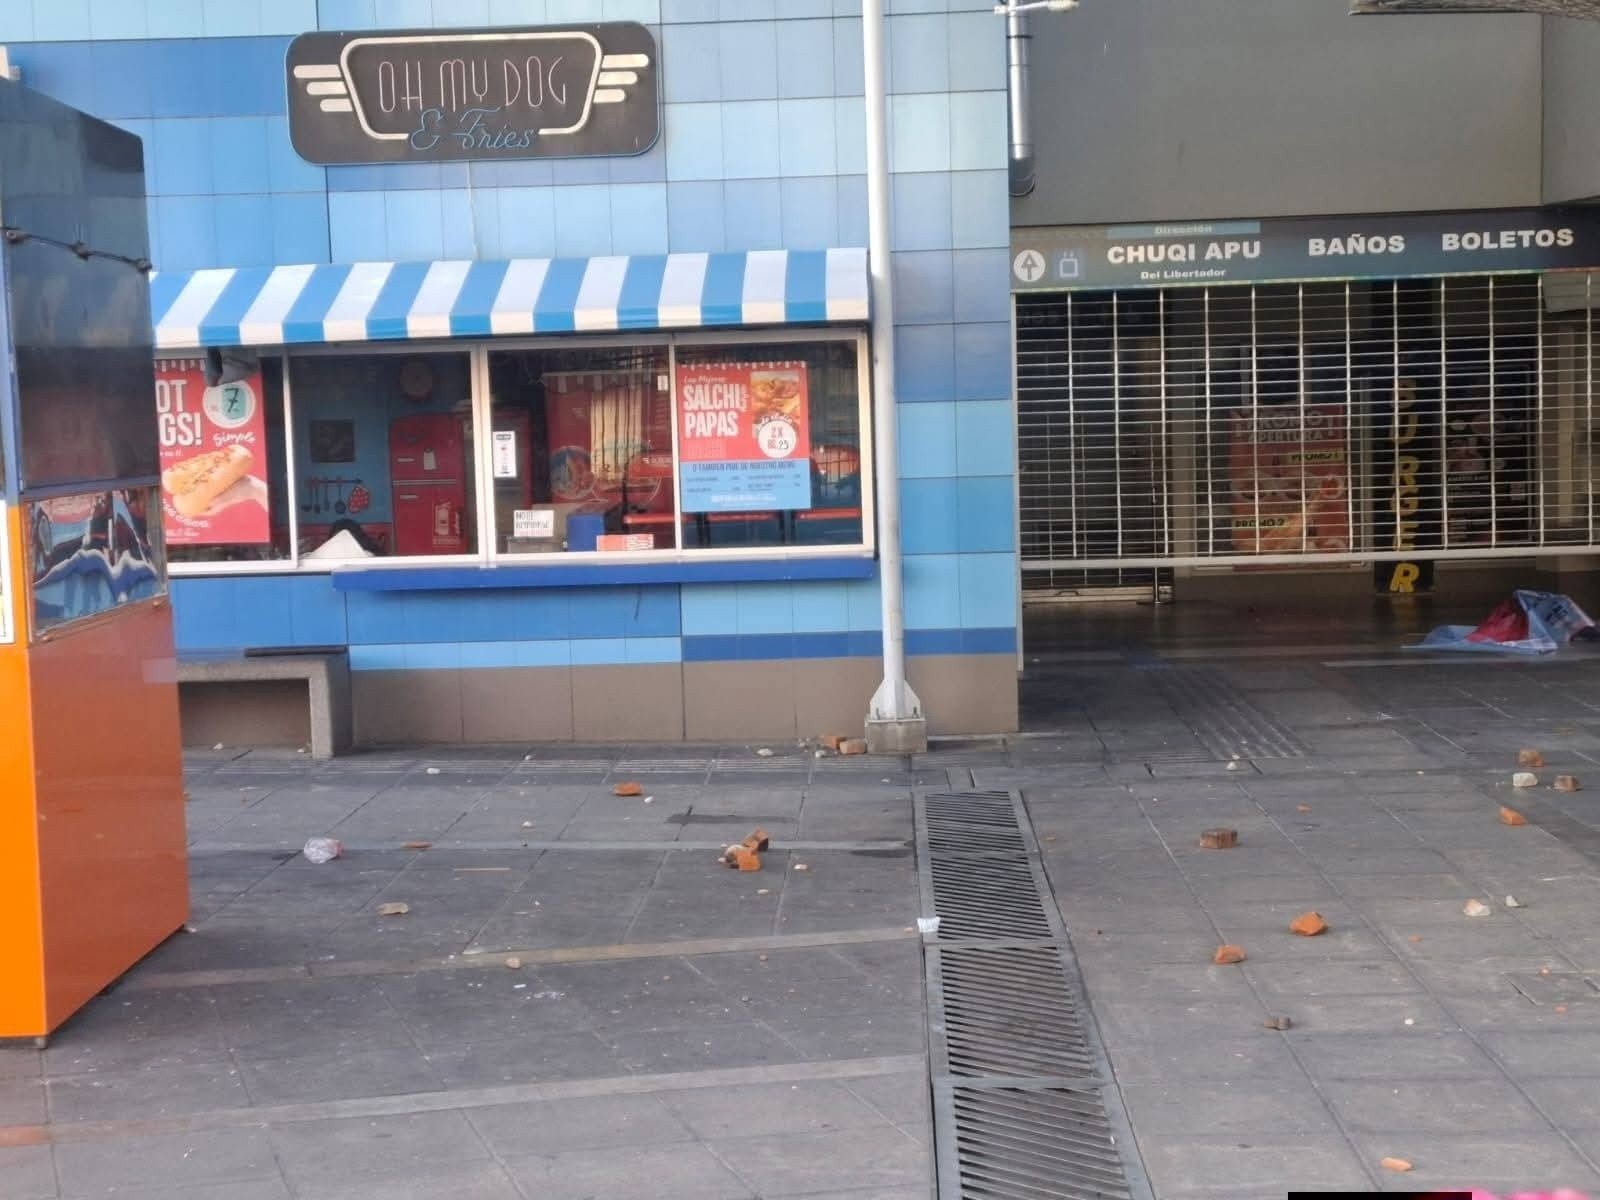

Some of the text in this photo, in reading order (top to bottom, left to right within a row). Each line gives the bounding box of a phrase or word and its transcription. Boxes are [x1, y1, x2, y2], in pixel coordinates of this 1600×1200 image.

[379, 56, 567, 113] OH MY DOG
[453, 105, 533, 149] Fries
[1107, 228, 1575, 265] CHUQI APU BAÑOS BOLETOS
[1141, 268, 1227, 280] Del Libertador
[155, 379, 187, 414] OT
[225, 387, 239, 414] 7
[159, 412, 202, 447] GS!
[685, 411, 739, 439] PAPAS
